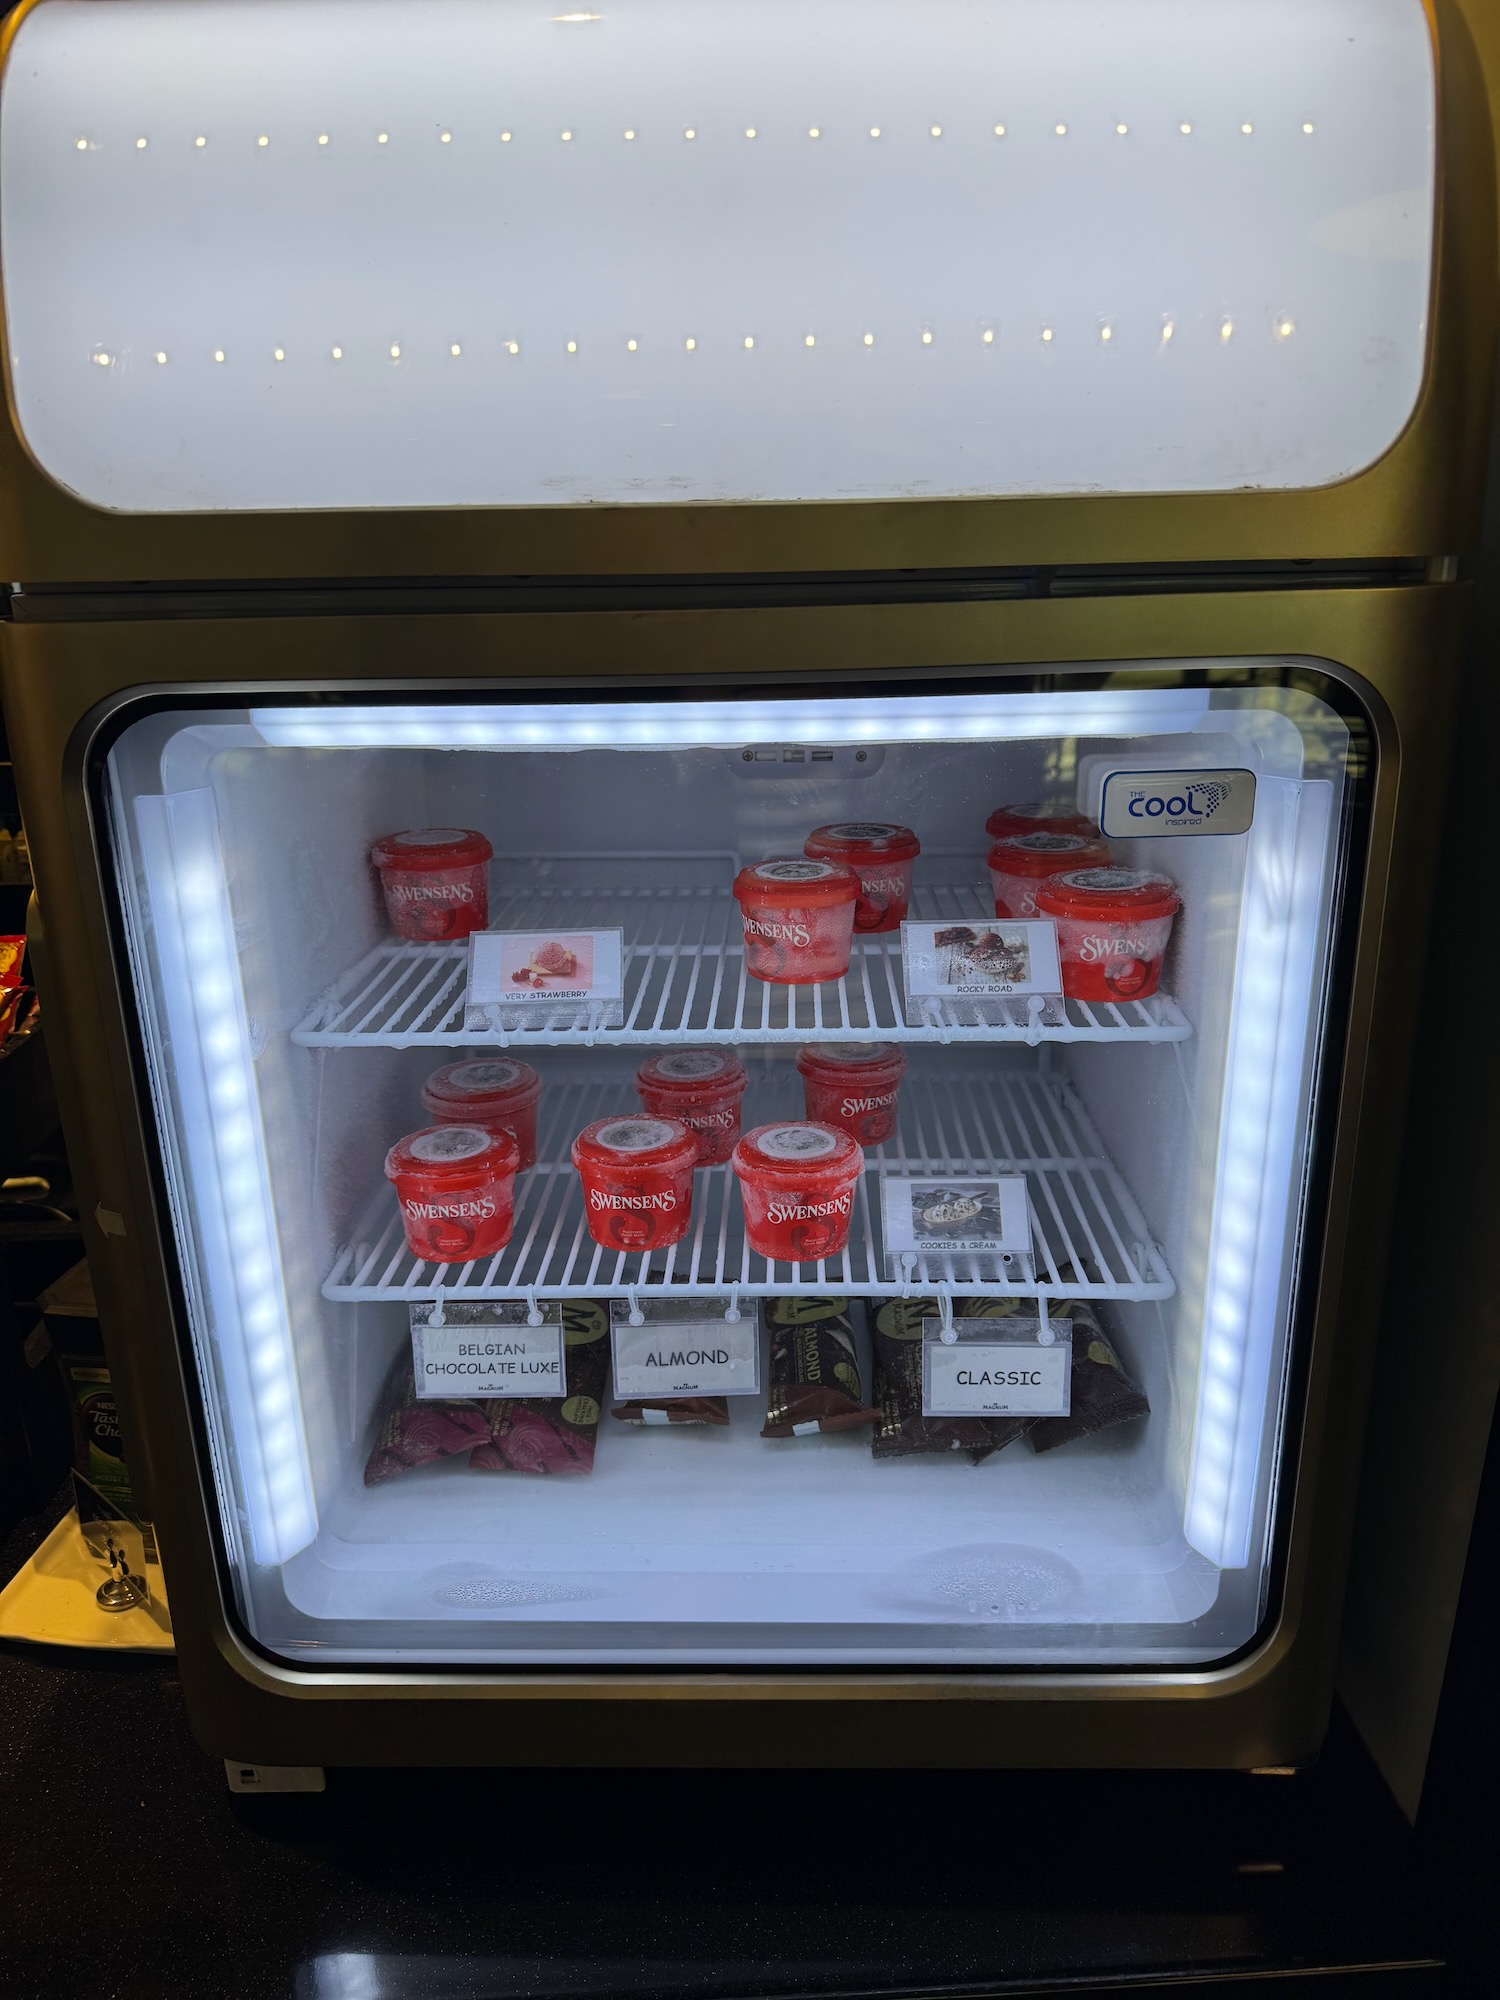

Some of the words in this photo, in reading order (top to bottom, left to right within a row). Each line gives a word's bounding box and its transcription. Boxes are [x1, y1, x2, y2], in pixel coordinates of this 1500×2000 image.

[1165, 818, 1202, 827] inspired
[861, 876, 906, 898] NSEN'S
[505, 991, 527, 1000] VERY
[529, 989, 588, 1000] STRAWBERRY
[957, 984, 984, 993] ROCKY
[988, 984, 1013, 993] ROAD
[840, 1090, 900, 1118] SWENSE
[678, 1108, 735, 1129] ENSEN'S
[405, 1195, 497, 1220] SWENSEN'S
[590, 1188, 677, 1213] SWENSEN'S
[766, 1191, 852, 1225] SWENSEN'S
[920, 1241, 958, 1251] COOKIES
[960, 1241, 967, 1250] &
[969, 1240, 998, 1250] CREAM
[458, 1343, 526, 1356] BELGIAN
[804, 1327, 821, 1381] ALMOND
[645, 1349, 730, 1368] ALMOND
[425, 1362, 516, 1376] CHOCOLATE
[520, 1361, 560, 1375] LUXE
[956, 1370, 1042, 1386] CLASSIC
[95, 1423, 121, 1438] Cho
